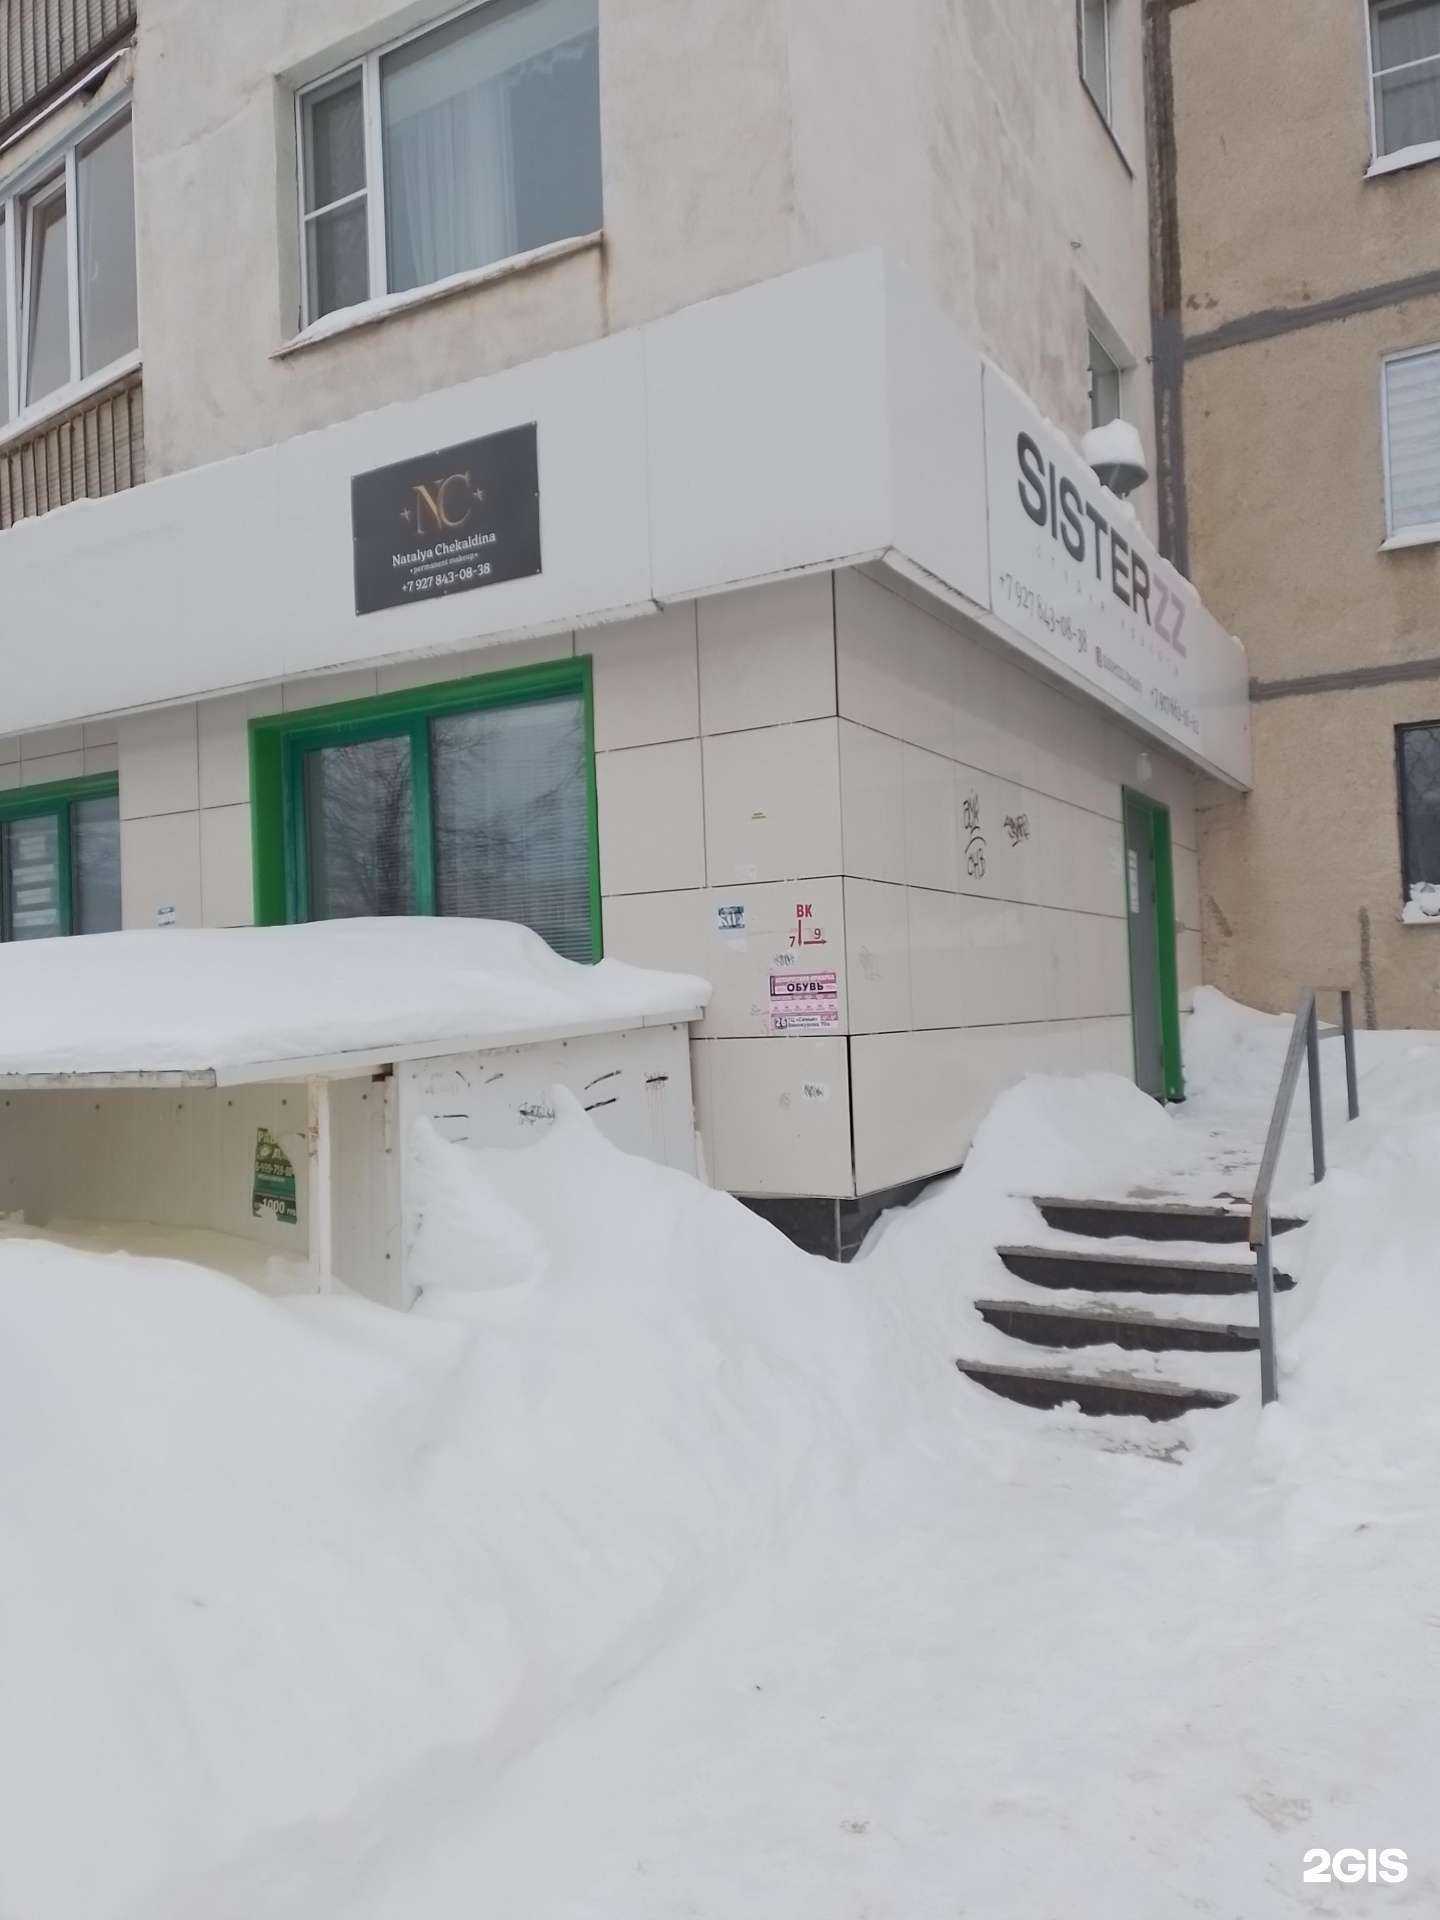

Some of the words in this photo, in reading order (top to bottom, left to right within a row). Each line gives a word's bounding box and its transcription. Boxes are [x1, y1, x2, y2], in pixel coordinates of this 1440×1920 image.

[412, 469, 472, 534] NC
[392, 549, 433, 567] Natalya
[434, 532, 496, 556] Chekaldina
[1017, 431, 1187, 659] SISTERZZ
[402, 580, 414, 593] +7
[416, 575, 434, 590] 927
[435, 562, 491, 586] 843-08-38
[789, 935, 796, 947] 7
[814, 928, 821, 939] 9
[787, 982, 824, 992] ОБУВЬ
